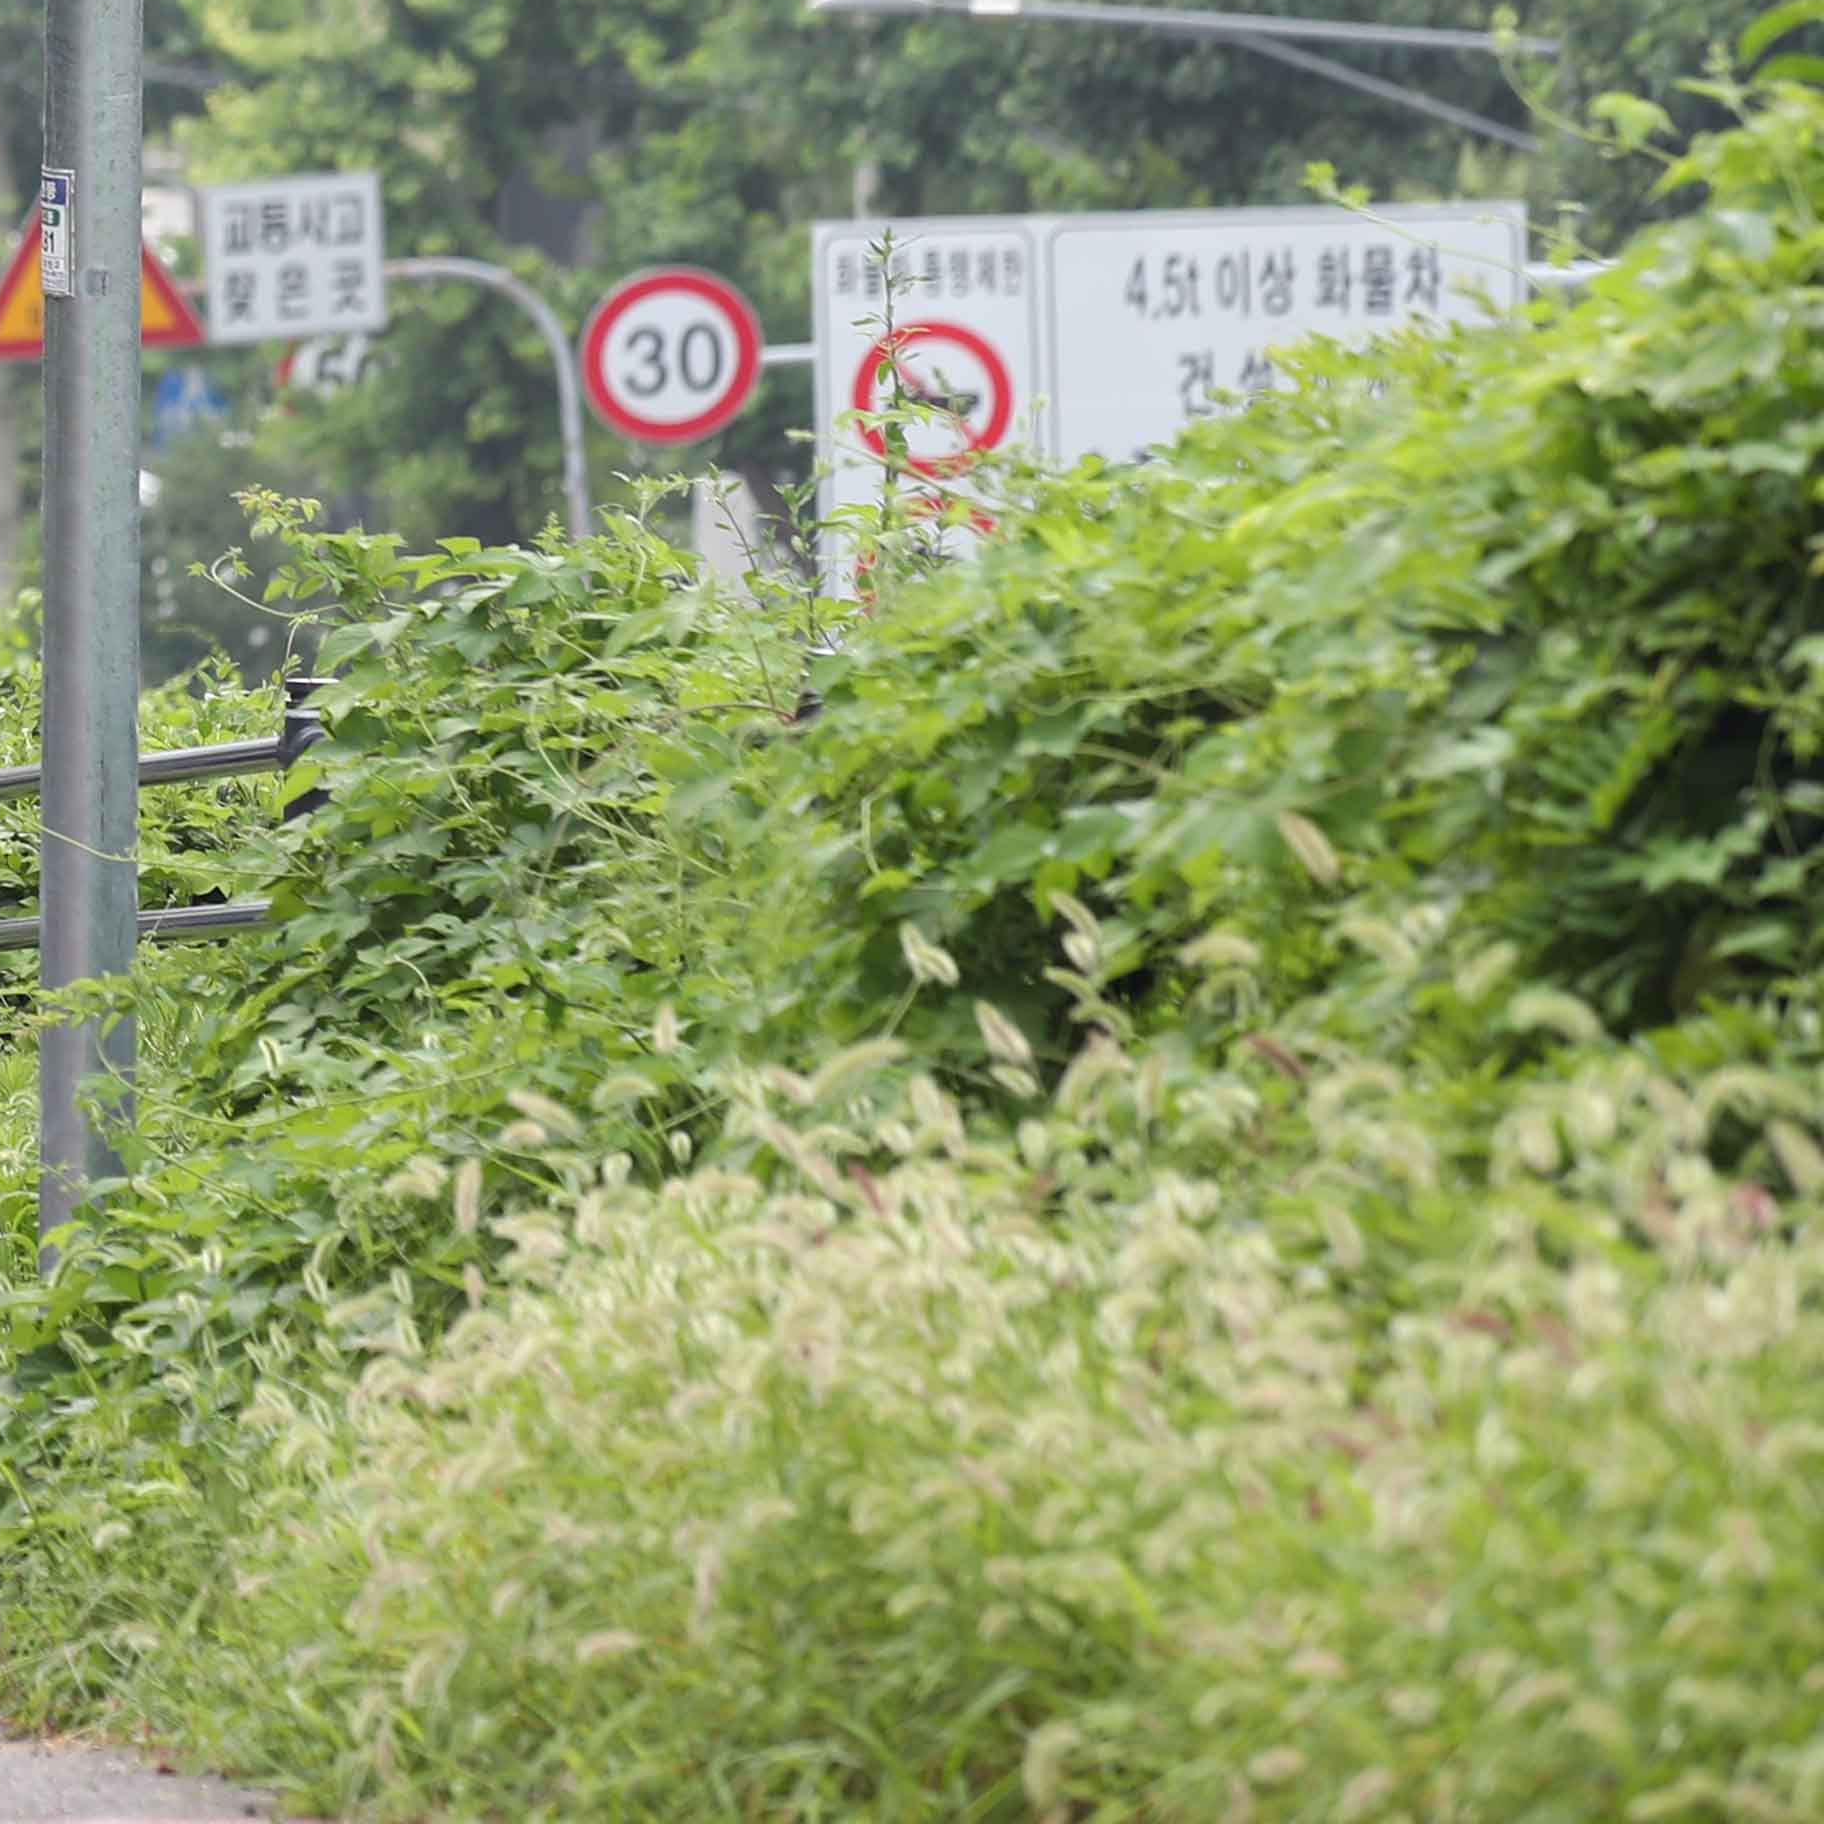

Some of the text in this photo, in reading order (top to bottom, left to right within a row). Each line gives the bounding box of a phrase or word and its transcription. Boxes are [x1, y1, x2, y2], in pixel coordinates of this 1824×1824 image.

[221, 192, 365, 256] 교통사고
[1123, 243, 1443, 319] 4.5t 이상 화물차
[624, 322, 725, 398] 30
